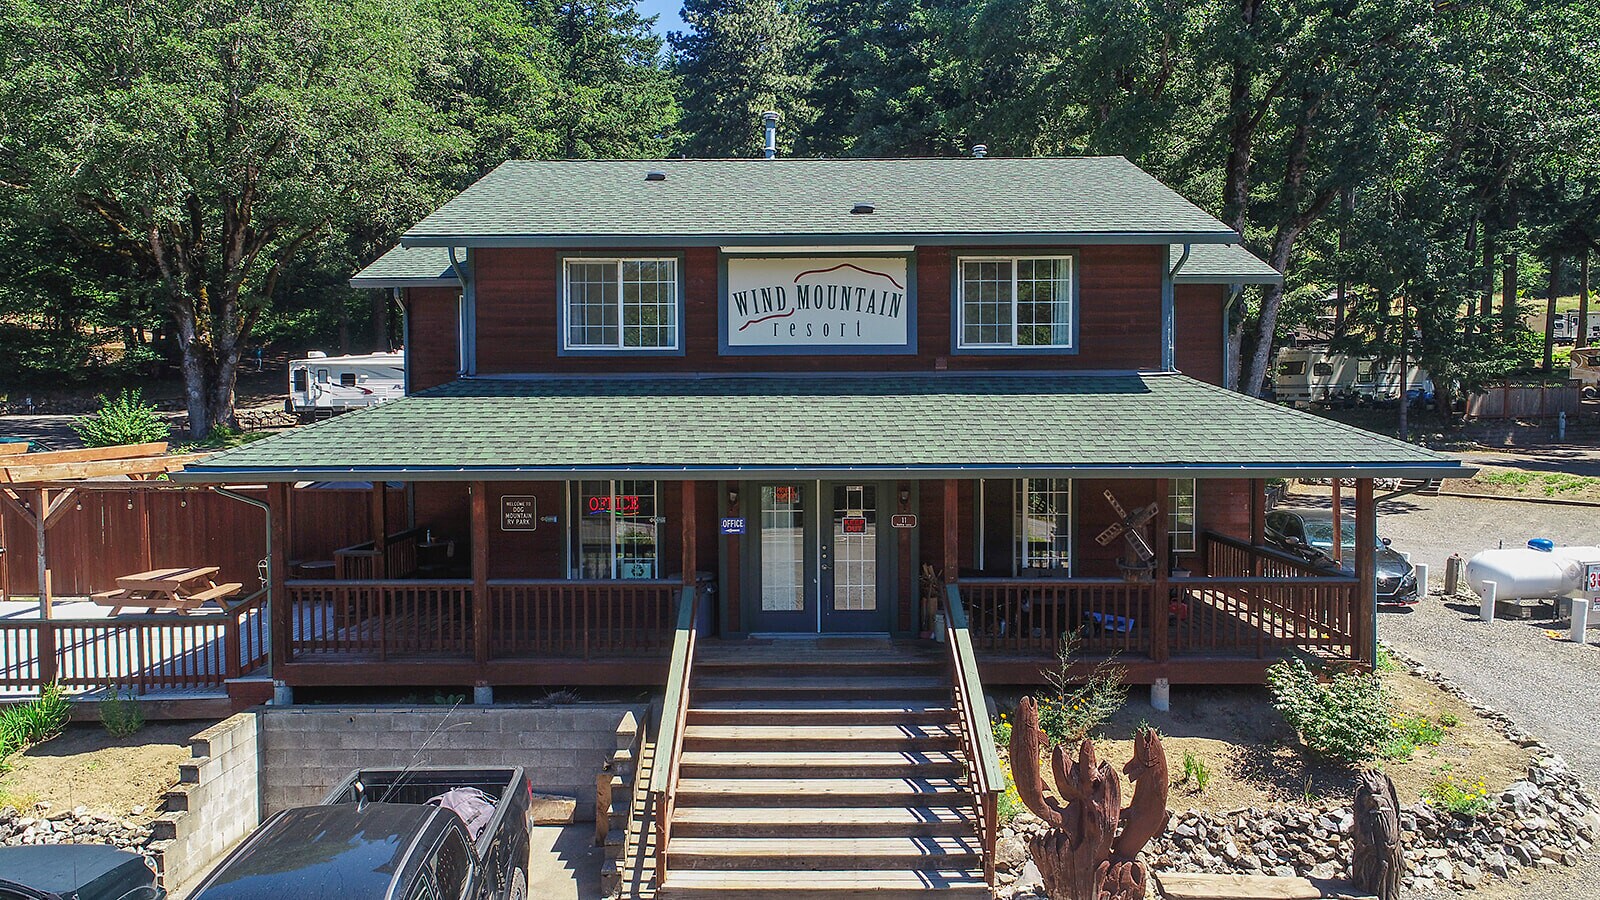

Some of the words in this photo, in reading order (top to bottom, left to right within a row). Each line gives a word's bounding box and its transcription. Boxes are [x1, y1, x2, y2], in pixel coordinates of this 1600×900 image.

[732, 286, 787, 317] WIND
[796, 284, 904, 319] MOUNTAIN
[773, 319, 862, 338] resort
[589, 496, 639, 511] OFFICE
[722, 519, 744, 528] OFFICE
